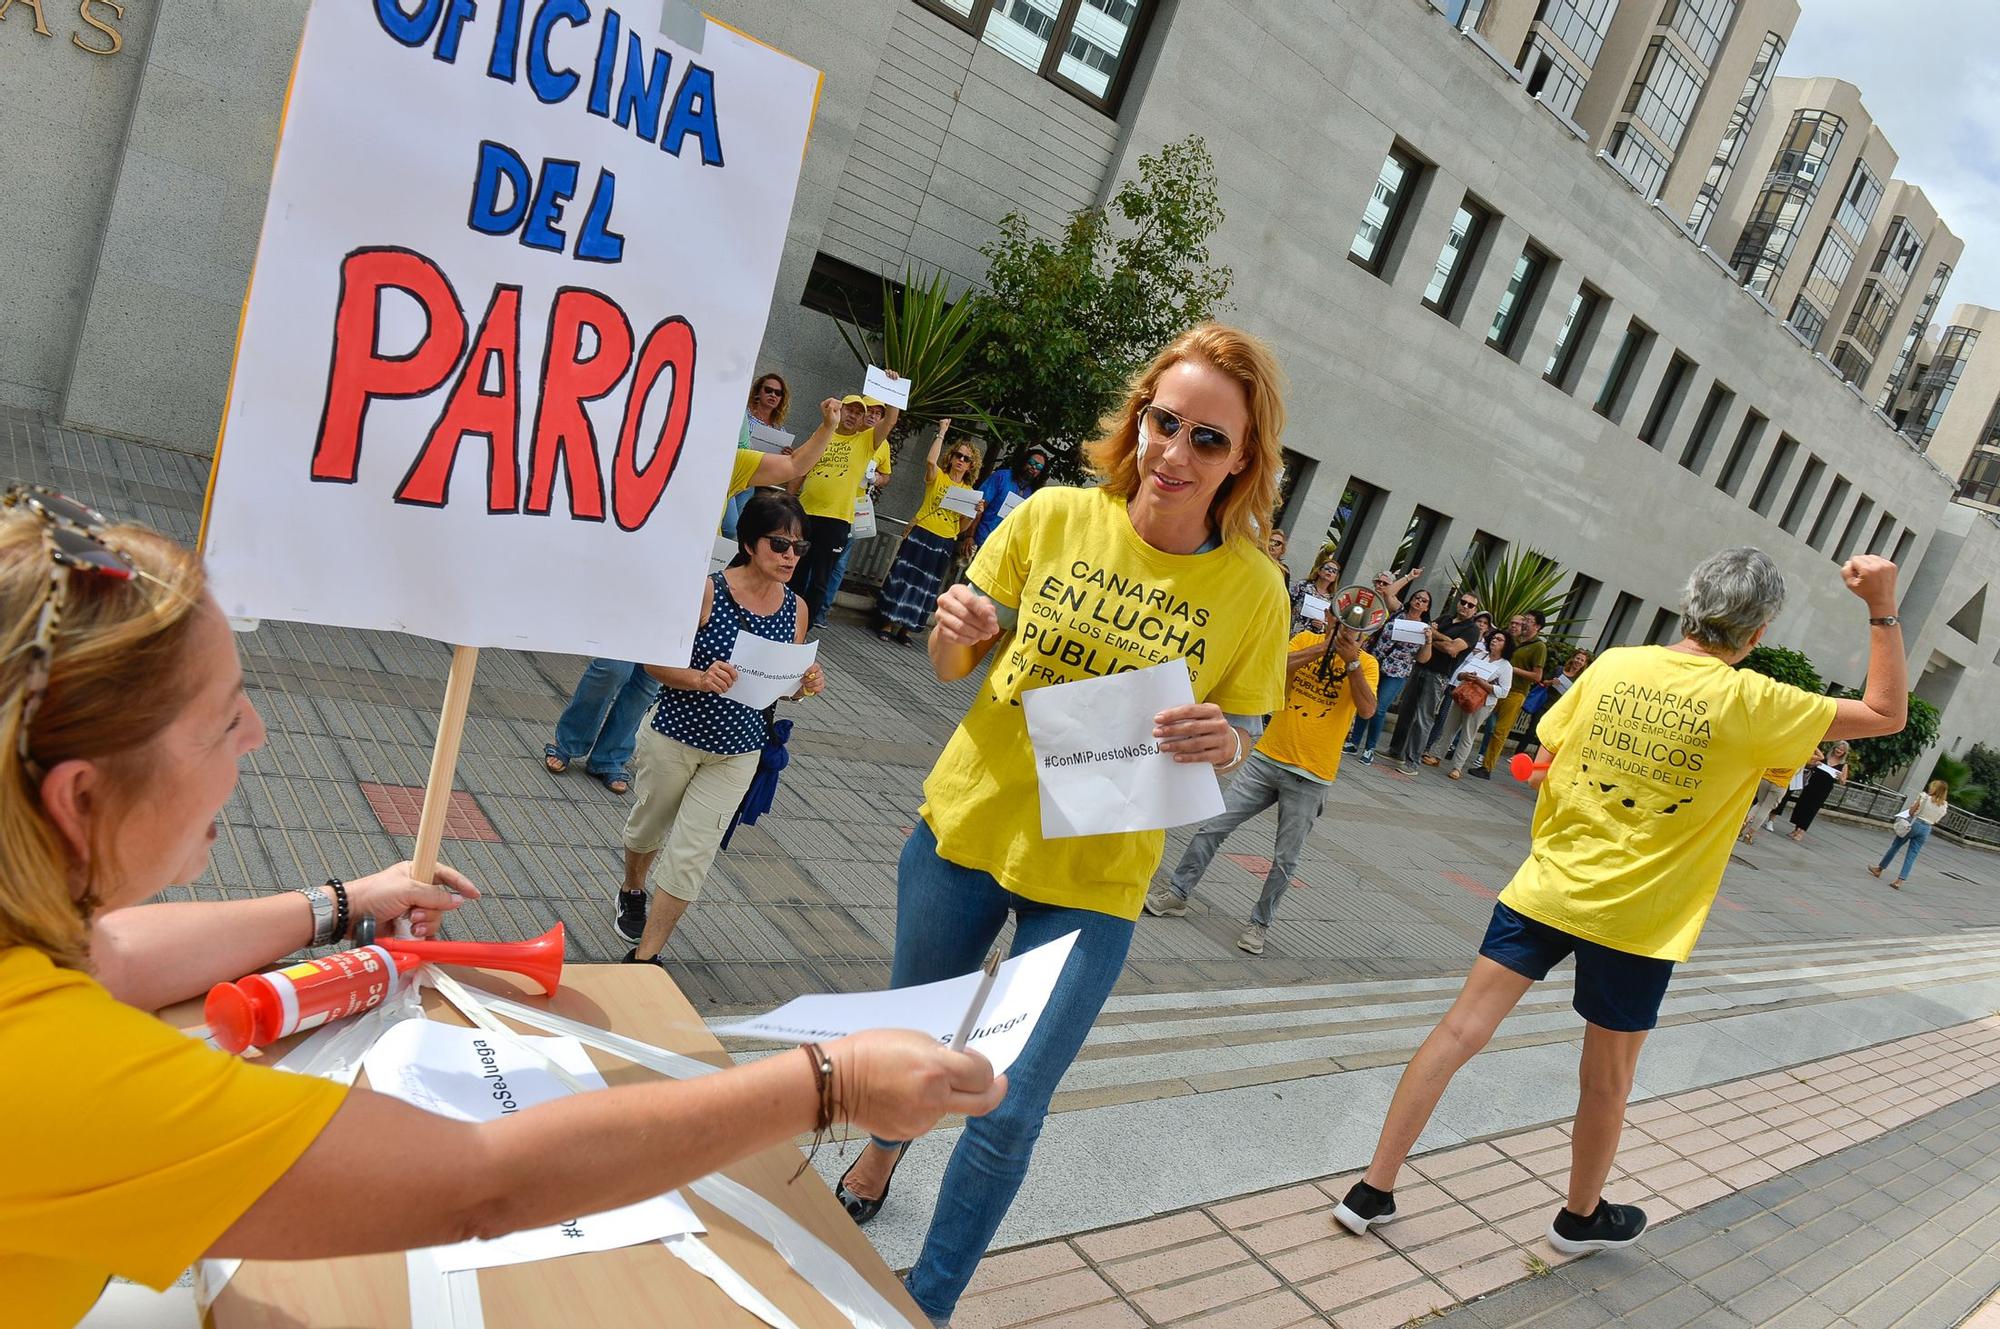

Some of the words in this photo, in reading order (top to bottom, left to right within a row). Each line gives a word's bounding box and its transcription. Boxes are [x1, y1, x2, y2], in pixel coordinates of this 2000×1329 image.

[468, 140, 625, 263] DEL
[311, 245, 697, 532] PARO
[1071, 561, 1210, 628] CANARIAS
[1032, 602, 1063, 624] CON
[1069, 617, 1102, 639] LOS
[1104, 632, 1199, 682] EMPLEAS
[1040, 576, 1086, 612] EN
[1092, 598, 1207, 665] LUCHA
[1011, 651, 1027, 672] EN
[1597, 694, 1626, 716] EN
[1631, 702, 1712, 740] LUCHA
[1614, 681, 1708, 716] CANARIAS
[1589, 724, 1704, 772] PÚBLICOS
[1594, 712, 1614, 724] CON
[1618, 718, 1640, 732] LOS
[1641, 724, 1709, 749] EMPLEADOS
[1582, 747, 1598, 760] EN
[1600, 753, 1650, 777] FRAUDE
[1652, 769, 1672, 783] DE
[1675, 775, 1702, 789] LEY
